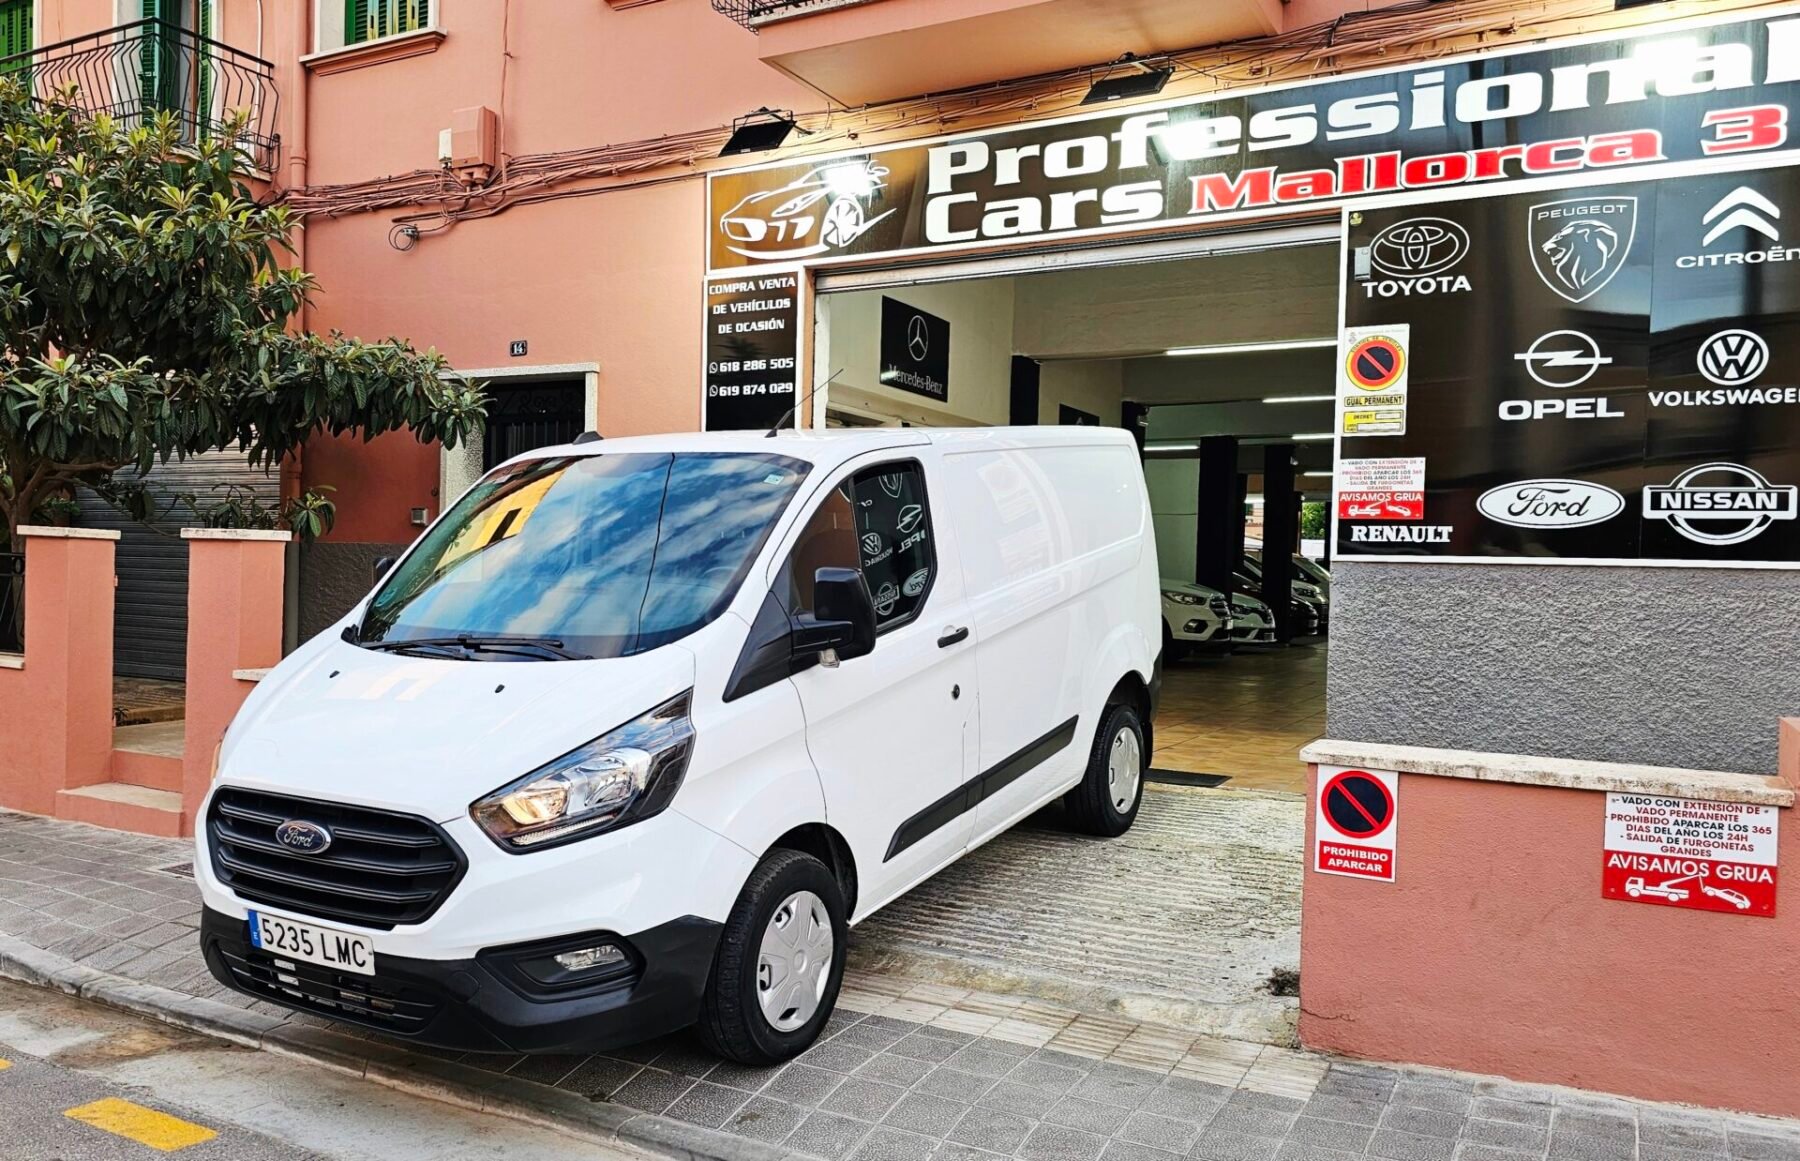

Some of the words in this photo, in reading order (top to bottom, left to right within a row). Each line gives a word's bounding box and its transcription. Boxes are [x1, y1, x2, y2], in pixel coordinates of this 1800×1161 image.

[927, 19, 1800, 195] Professional
[926, 180, 1163, 243] Cars
[1188, 128, 1668, 215] Mallorca
[1700, 104, 1788, 156] 3
[1537, 204, 1627, 221] PEUGEOT
[708, 281, 756, 295] COMPRA
[758, 277, 796, 290] VENTA
[1362, 275, 1472, 298] TOYOTA
[712, 304, 728, 315] DE
[730, 298, 791, 313] VEHÍCULOS
[718, 323, 732, 334] DE
[735, 317, 785, 333] OCASIÓN
[719, 361, 740, 373] 618
[743, 359, 767, 371] 286
[769, 357, 794, 369] 505
[889, 363, 943, 395] Mercedes-Benz
[719, 385, 740, 397] 619
[742, 384, 766, 395] 874
[769, 382, 793, 394] 029
[1648, 387, 1800, 407] VOLKSWAGE
[1364, 396, 1402, 405] PERMANENT
[1499, 397, 1625, 420] OPEL
[1340, 492, 1392, 502] AVISAMOS
[1393, 492, 1423, 502] GRUA
[1507, 487, 1592, 517] Ford
[1660, 492, 1778, 510] NISSAN
[1351, 525, 1453, 543] RENAULT
[1622, 796, 1652, 806] VADO
[1655, 798, 1680, 808] CON
[1683, 800, 1743, 813] EXTENSIÓN
[1746, 806, 1761, 815] DE
[1636, 806, 1666, 816] VADO
[1669, 808, 1739, 822] PERMANENTE
[1611, 813, 1670, 826] PROHIBIDO
[1673, 819, 1725, 831] APARCAR
[1728, 823, 1749, 833] LOS
[1752, 826, 1772, 835] 365
[1626, 823, 1651, 833] DIAS
[1653, 826, 1672, 835] DEL
[1675, 826, 1700, 838] AÑO
[1703, 830, 1724, 840] LOS
[1727, 833, 1749, 842] 24H
[284, 825, 315, 847] Ford
[1626, 833, 1663, 844] SALIDA
[1666, 835, 1680, 845] DE
[1683, 838, 1754, 852] FURGONETAS
[1323, 845, 1389, 862] PROHIBIDO
[1660, 846, 1712, 857] GRANDES
[1327, 858, 1383, 873] APARCAR
[1607, 853, 1710, 877] AVISAMOS
[1716, 864, 1774, 884] GRUA
[262, 918, 314, 956] 5235
[320, 933, 366, 967] LMC
